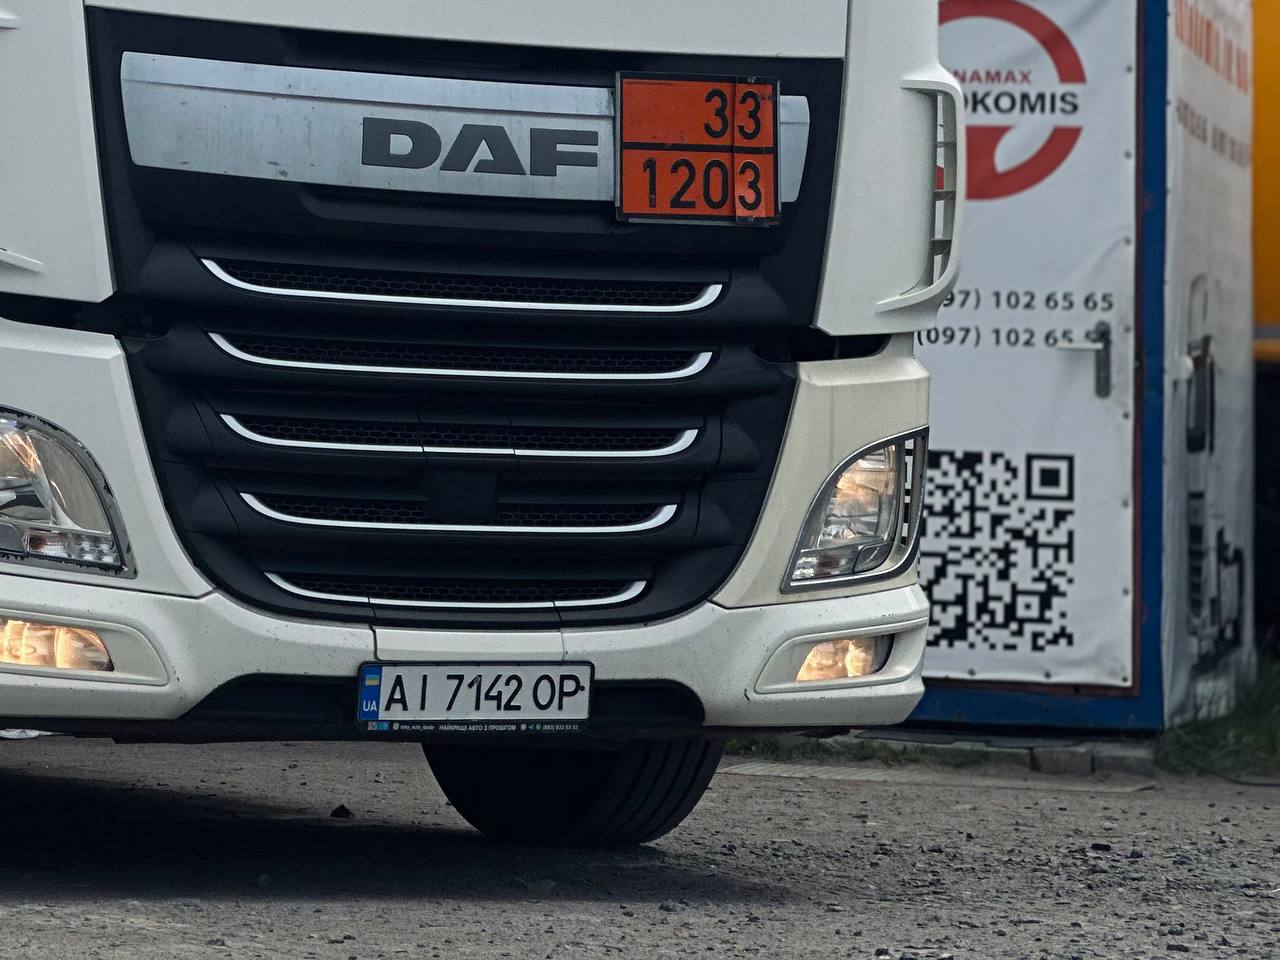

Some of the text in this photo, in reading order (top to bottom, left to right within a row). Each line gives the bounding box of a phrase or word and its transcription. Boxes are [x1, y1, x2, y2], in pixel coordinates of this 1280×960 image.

[953, 69, 1032, 84] NAMAX
[703, 89, 762, 140] 33
[964, 91, 1080, 115] KOMIS
[361, 117, 599, 177] DAF
[642, 157, 763, 212] 1203
[942, 290, 1114, 312] 97) 102 65 65
[917, 326, 981, 348] (097)
[992, 328, 1036, 348] 102
[384, 674, 581, 711] AI 7142 OP
[363, 699, 378, 712] UA
